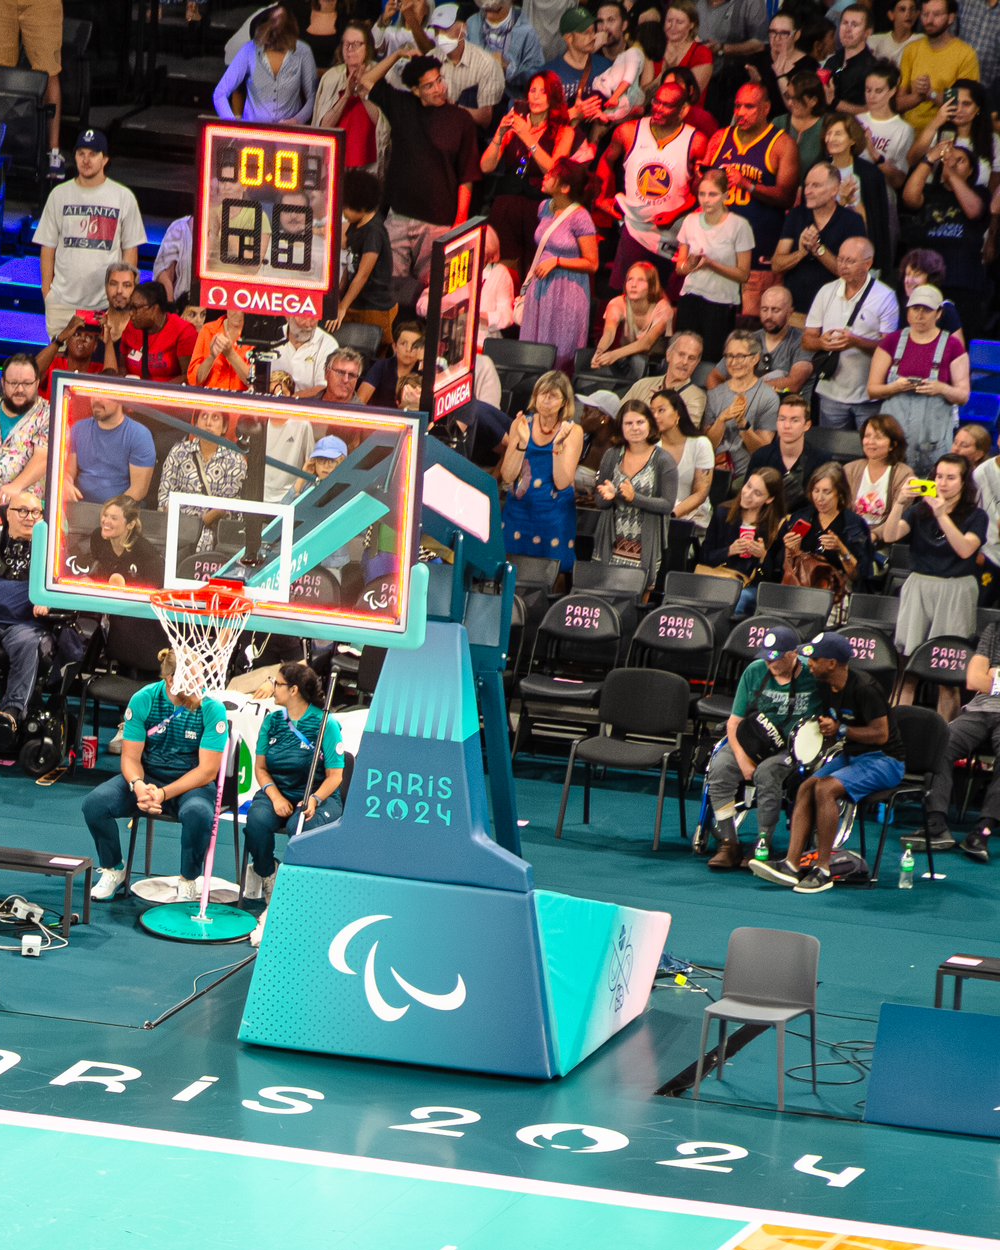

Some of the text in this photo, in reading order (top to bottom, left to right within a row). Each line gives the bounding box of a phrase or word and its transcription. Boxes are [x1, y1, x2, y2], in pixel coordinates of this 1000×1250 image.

[240, 146, 299, 190] 0.0
[653, 166, 667, 181] 30
[64, 206, 117, 217] ATLANTA
[80, 219, 98, 234] 96
[233, 289, 317, 315] OMEGA
[444, 381, 470, 409] OMEGA
[564, 616, 599, 629] 2024
[658, 627, 693, 640] 2024
[930, 658, 966, 671] 2024
[755, 712, 785, 748] EASTPAK
[365, 795, 451, 826] 2024
[389, 1106, 866, 1188] 2024
